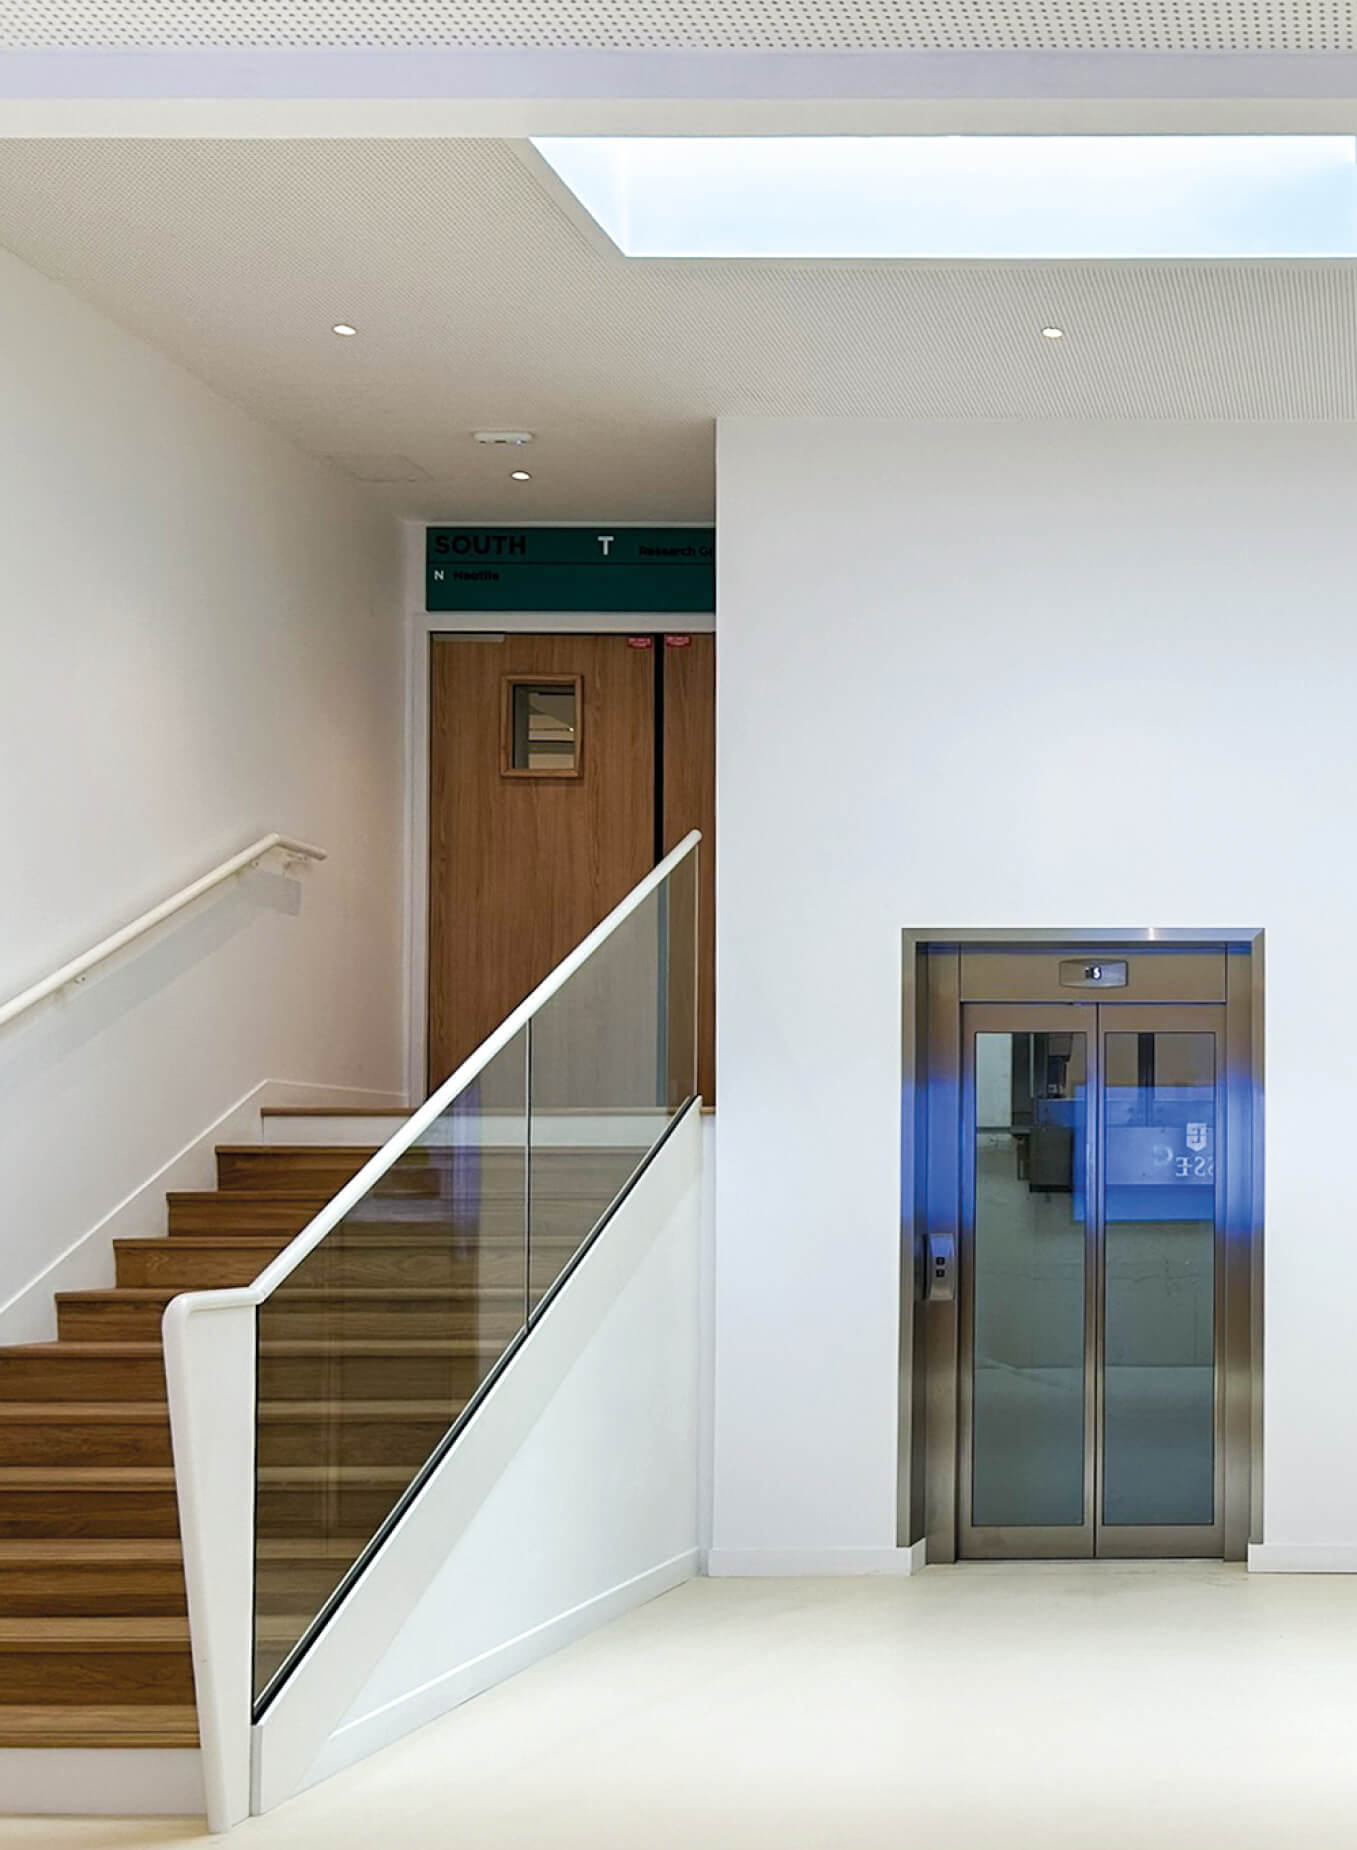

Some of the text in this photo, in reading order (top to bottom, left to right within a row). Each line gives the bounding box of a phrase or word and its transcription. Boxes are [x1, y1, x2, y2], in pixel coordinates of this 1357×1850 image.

[435, 535, 526, 555] SOUTH
[597, 535, 614, 556] T
[639, 544, 696, 557] Research
[433, 568, 445, 581] N
